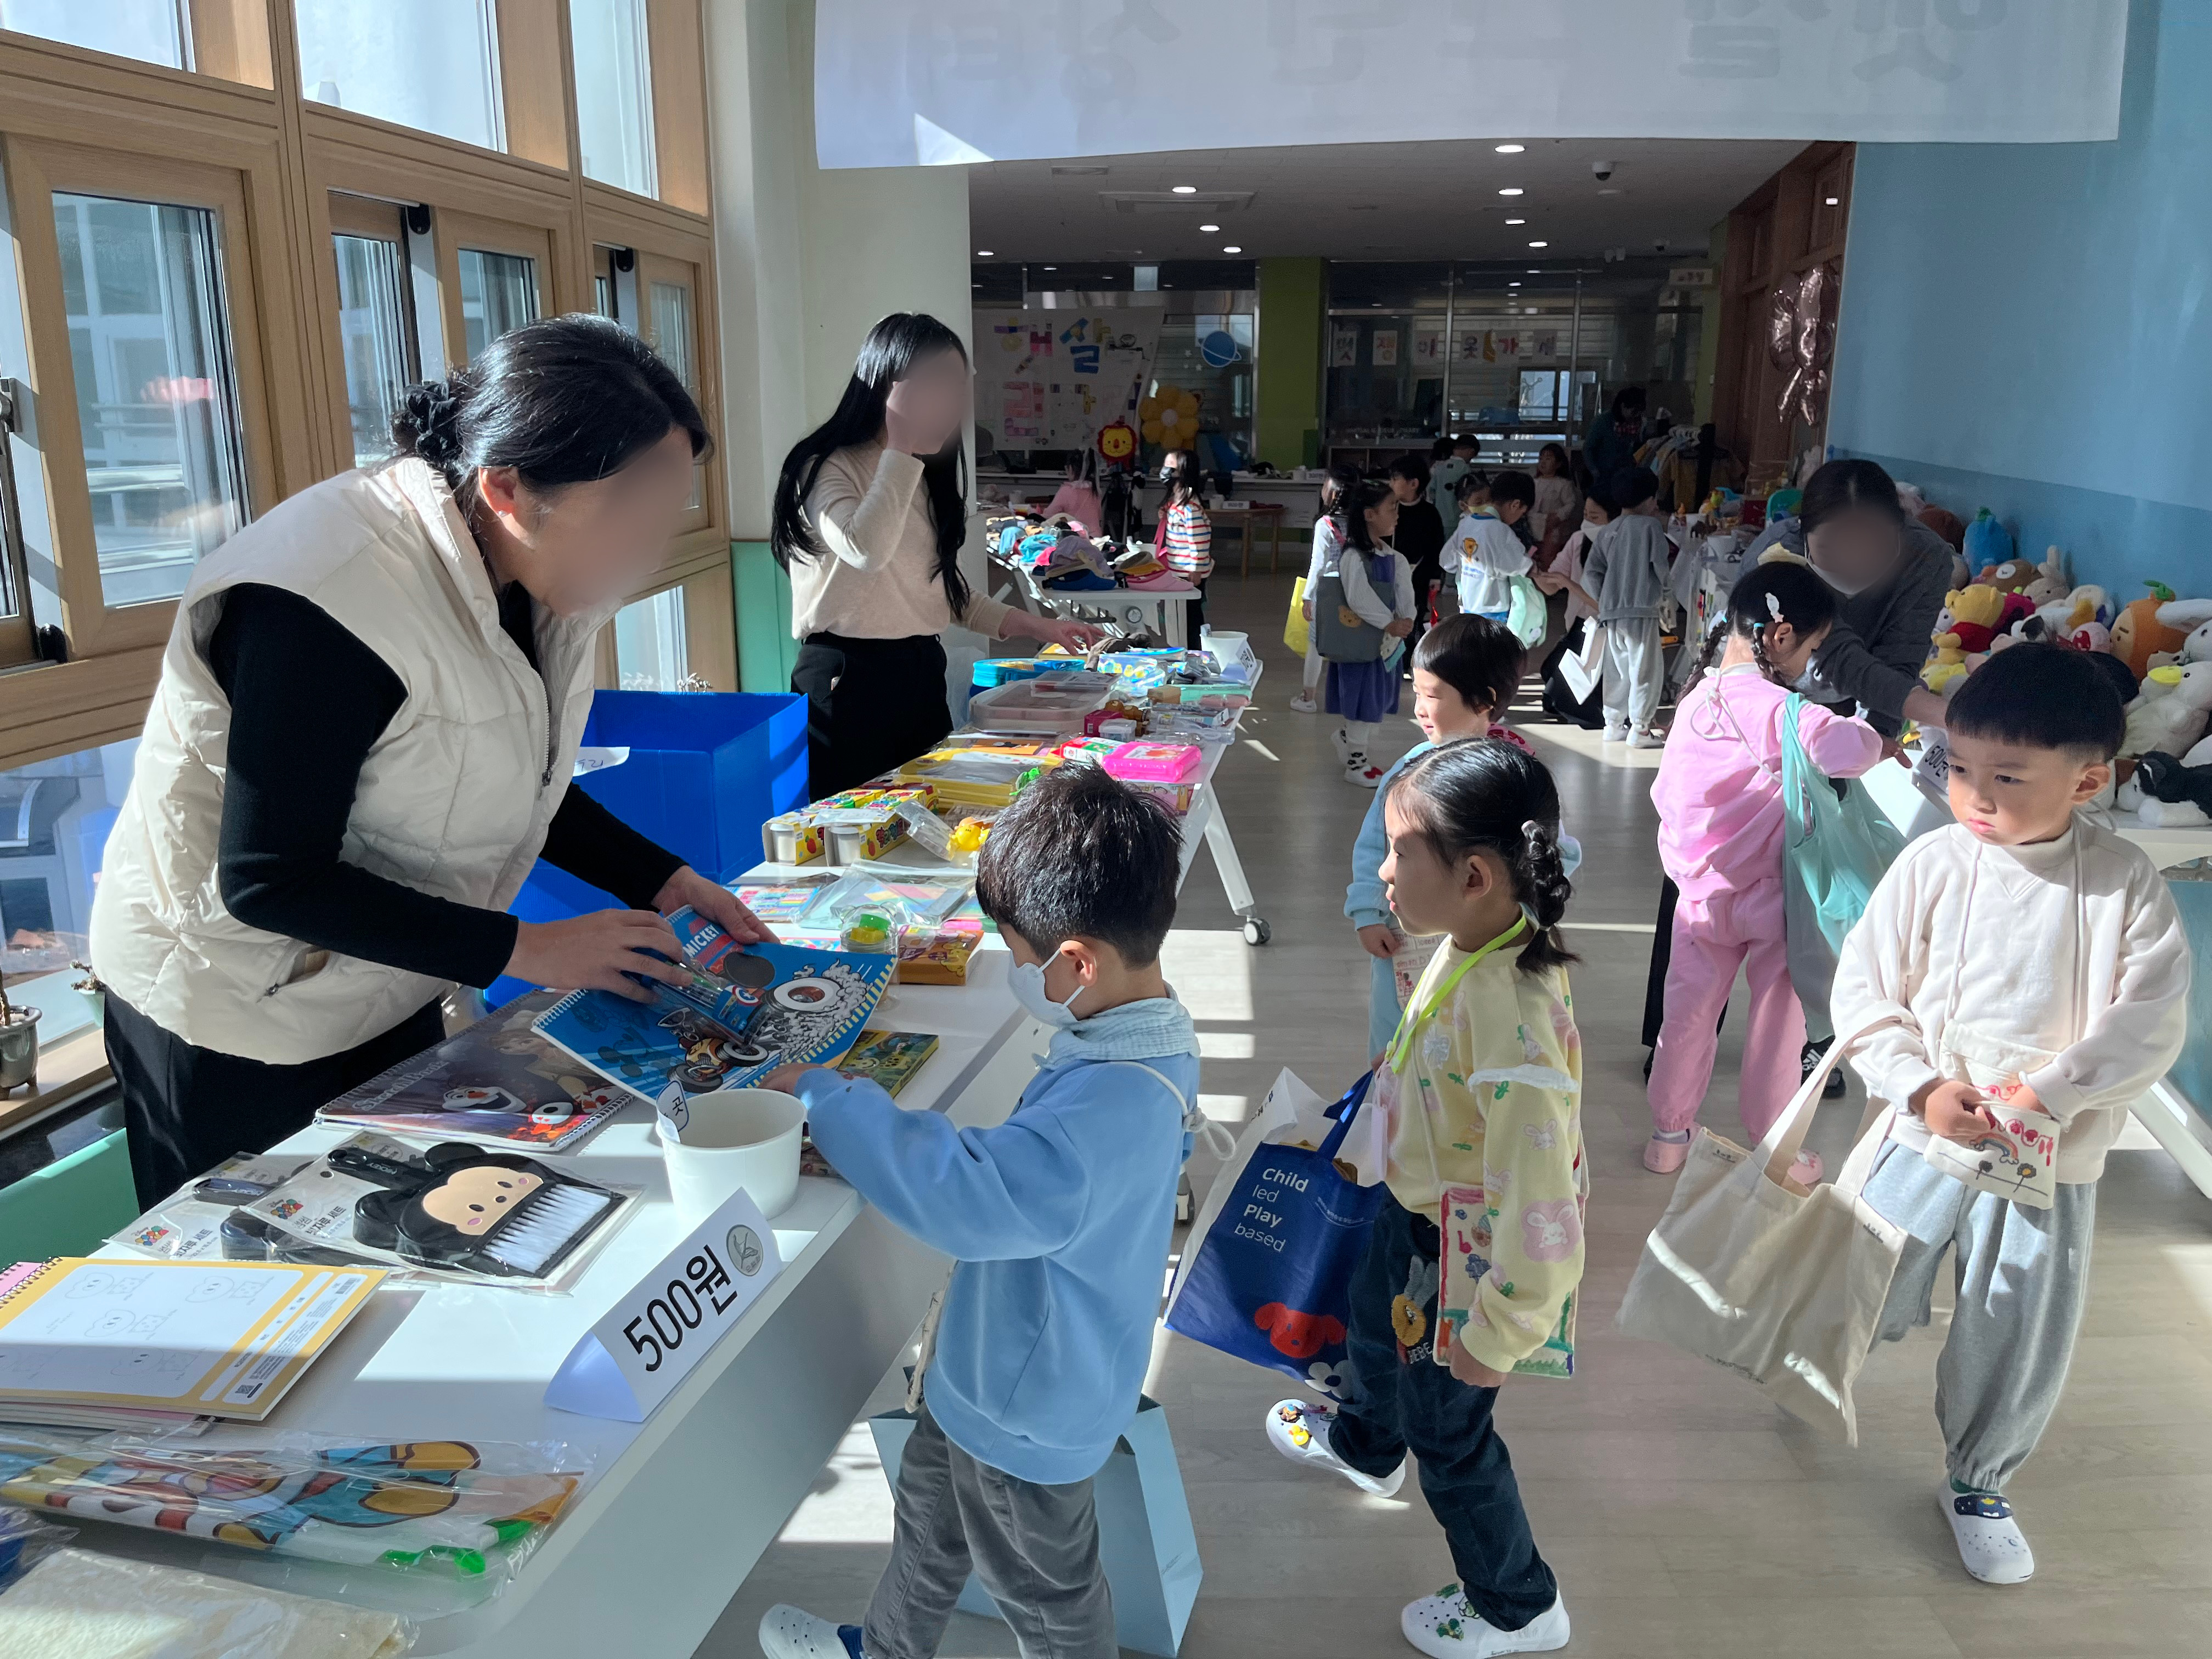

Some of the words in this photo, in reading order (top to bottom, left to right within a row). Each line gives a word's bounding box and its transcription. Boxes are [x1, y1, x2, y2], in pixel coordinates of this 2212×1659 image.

[682, 924, 719, 958] MICKEY
[1252, 1185, 1279, 1203] led
[1262, 1169, 1309, 1193] Child
[1244, 1204, 1283, 1228] Play
[1234, 1223, 1286, 1252] based
[623, 1244, 737, 1372] 500원
